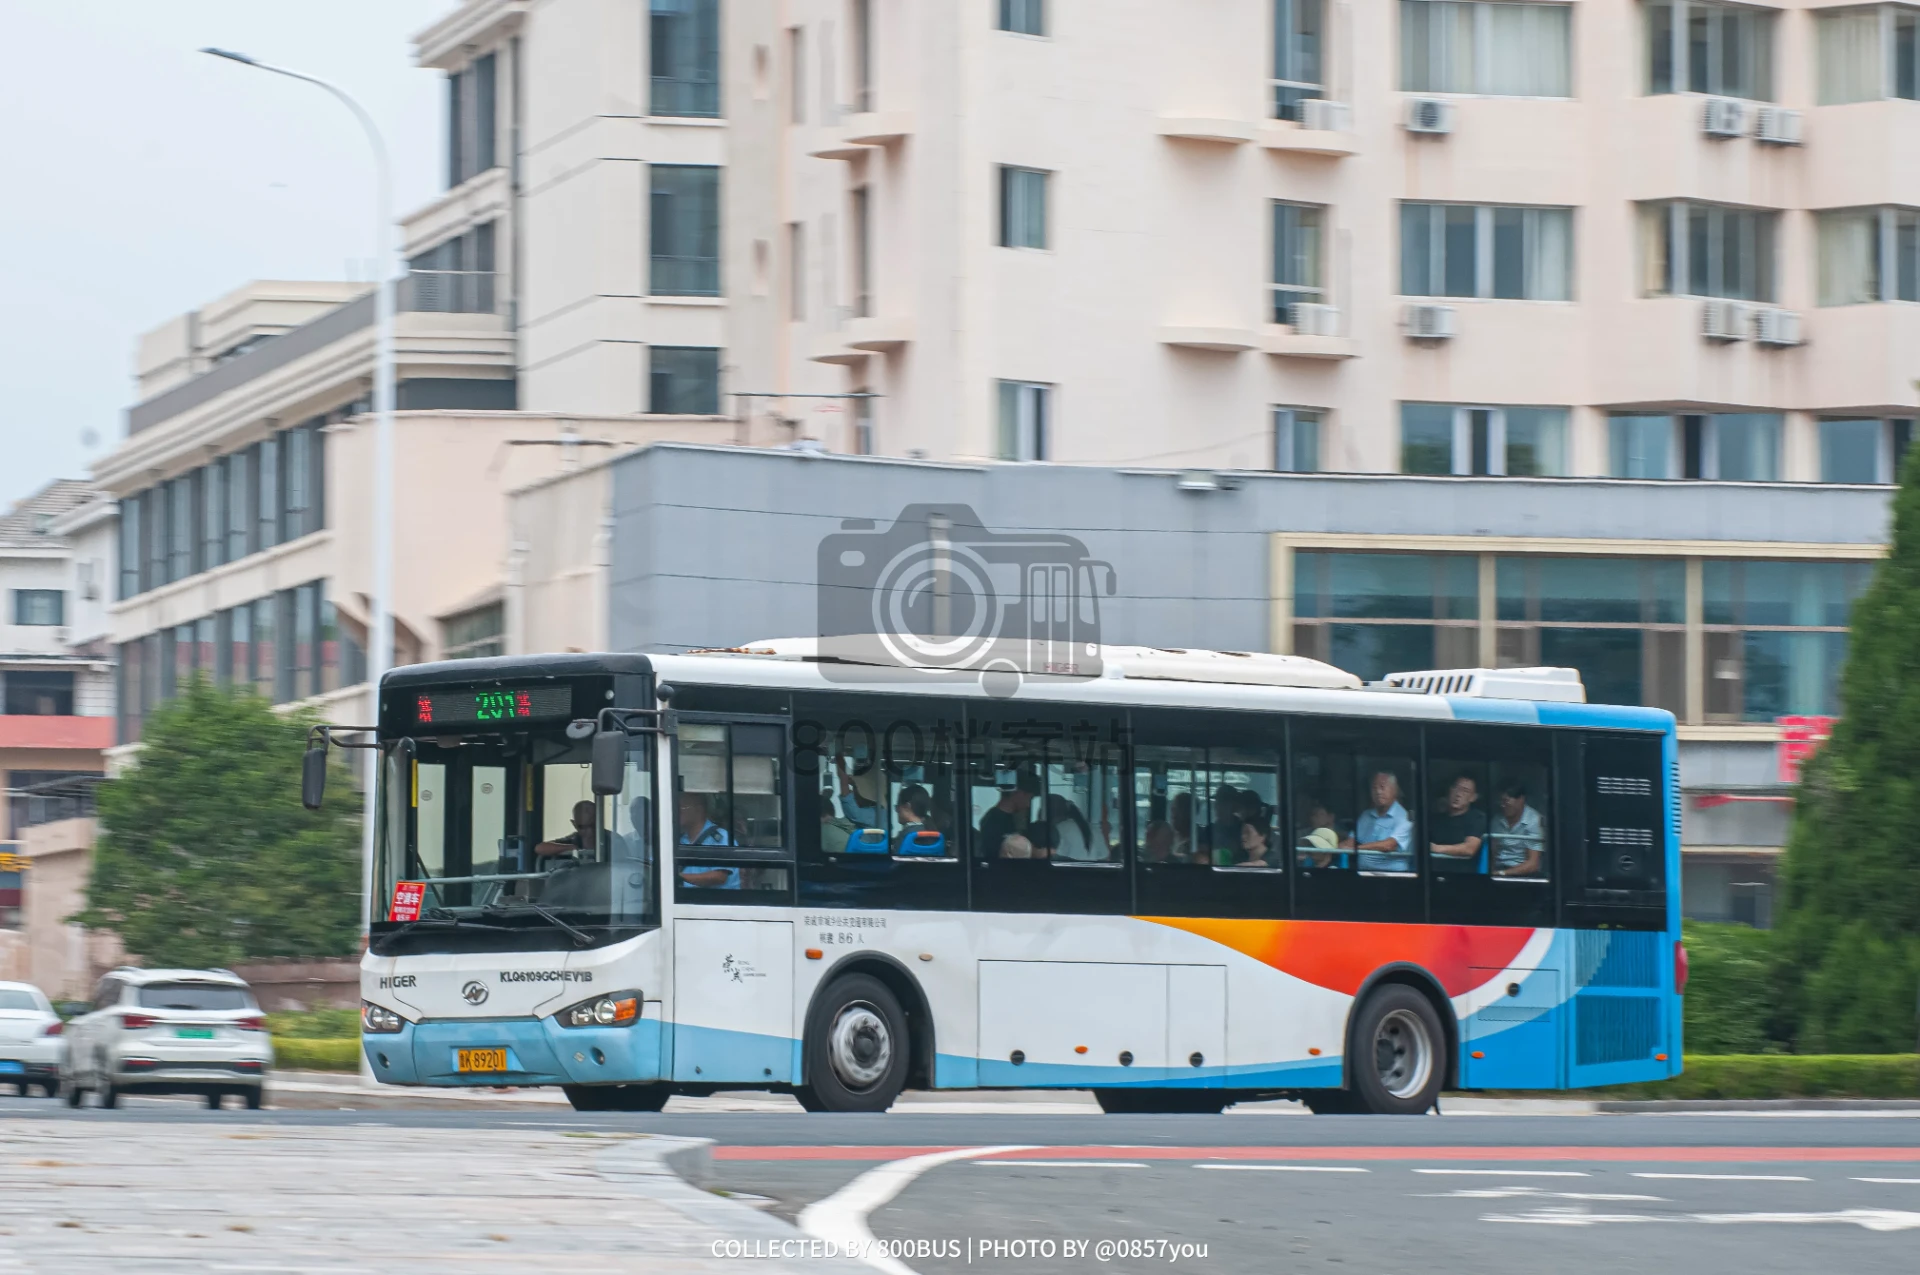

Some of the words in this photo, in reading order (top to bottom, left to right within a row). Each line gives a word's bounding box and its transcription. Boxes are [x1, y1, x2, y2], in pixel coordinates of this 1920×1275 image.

[476, 691, 514, 719] 201
[838, 932, 853, 944] 86
[380, 976, 416, 988] HIGER
